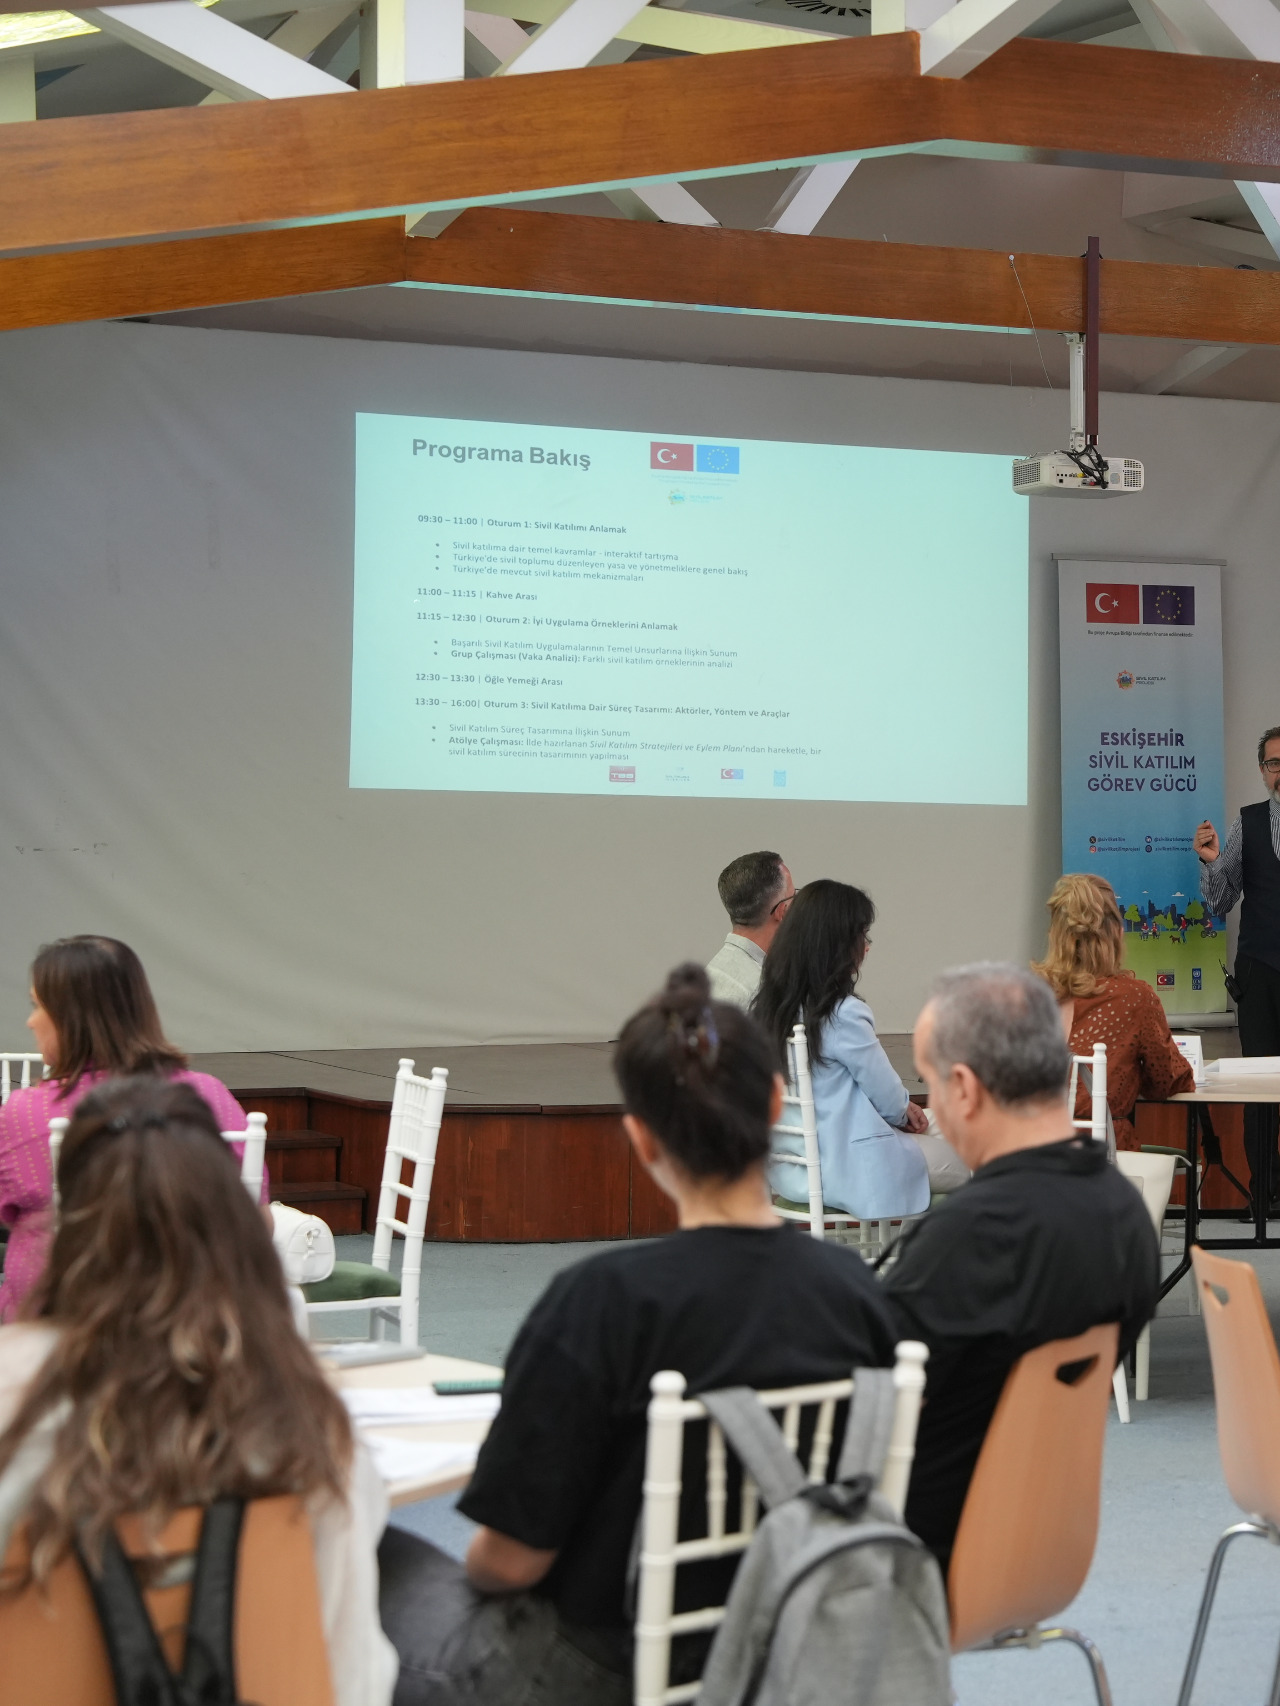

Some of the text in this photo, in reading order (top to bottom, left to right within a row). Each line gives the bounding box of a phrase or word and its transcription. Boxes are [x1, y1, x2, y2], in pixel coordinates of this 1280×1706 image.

[412, 438, 592, 471] Programa Bakış
[417, 514, 443, 523] 09:30
[453, 516, 478, 525] 11:00
[486, 518, 521, 527] Oturum
[534, 521, 552, 529] Sivil
[553, 522, 587, 531] Katılımı
[588, 524, 626, 533] Anlamak
[417, 587, 442, 596] 11:00
[452, 589, 476, 597] 11:15
[486, 590, 513, 599] Kahve
[515, 592, 537, 600] Arası
[416, 612, 441, 620] 11:15
[451, 614, 476, 622] 12:30
[485, 615, 520, 623] Oturum
[532, 616, 543, 627] İyi
[545, 618, 589, 628] Uygulama
[590, 618, 639, 628] Örneklerini
[640, 621, 678, 630] Anlamak
[415, 673, 440, 681] 12:30
[450, 674, 475, 682] 13:30
[484, 674, 504, 685] Öğle
[506, 676, 539, 687] Yemeği
[540, 677, 563, 685] Arası
[415, 697, 440, 706] 13:30
[483, 700, 518, 708] Oturum
[530, 701, 549, 709] Sivil
[550, 702, 586, 710] Katılıma
[588, 703, 606, 711] Dair
[608, 704, 632, 714] Süreç
[634, 705, 672, 713] Tasarımı:
[674, 706, 712, 717] Aktörler,
[714, 707, 746, 716] Yöntem
[760, 709, 790, 719] Araçlar
[1100, 727, 1185, 749] ESKİŞEHİR
[1088, 751, 1196, 770] SİVİL KATILIM
[1087, 774, 1197, 792] GÖREV GÜCÜ
